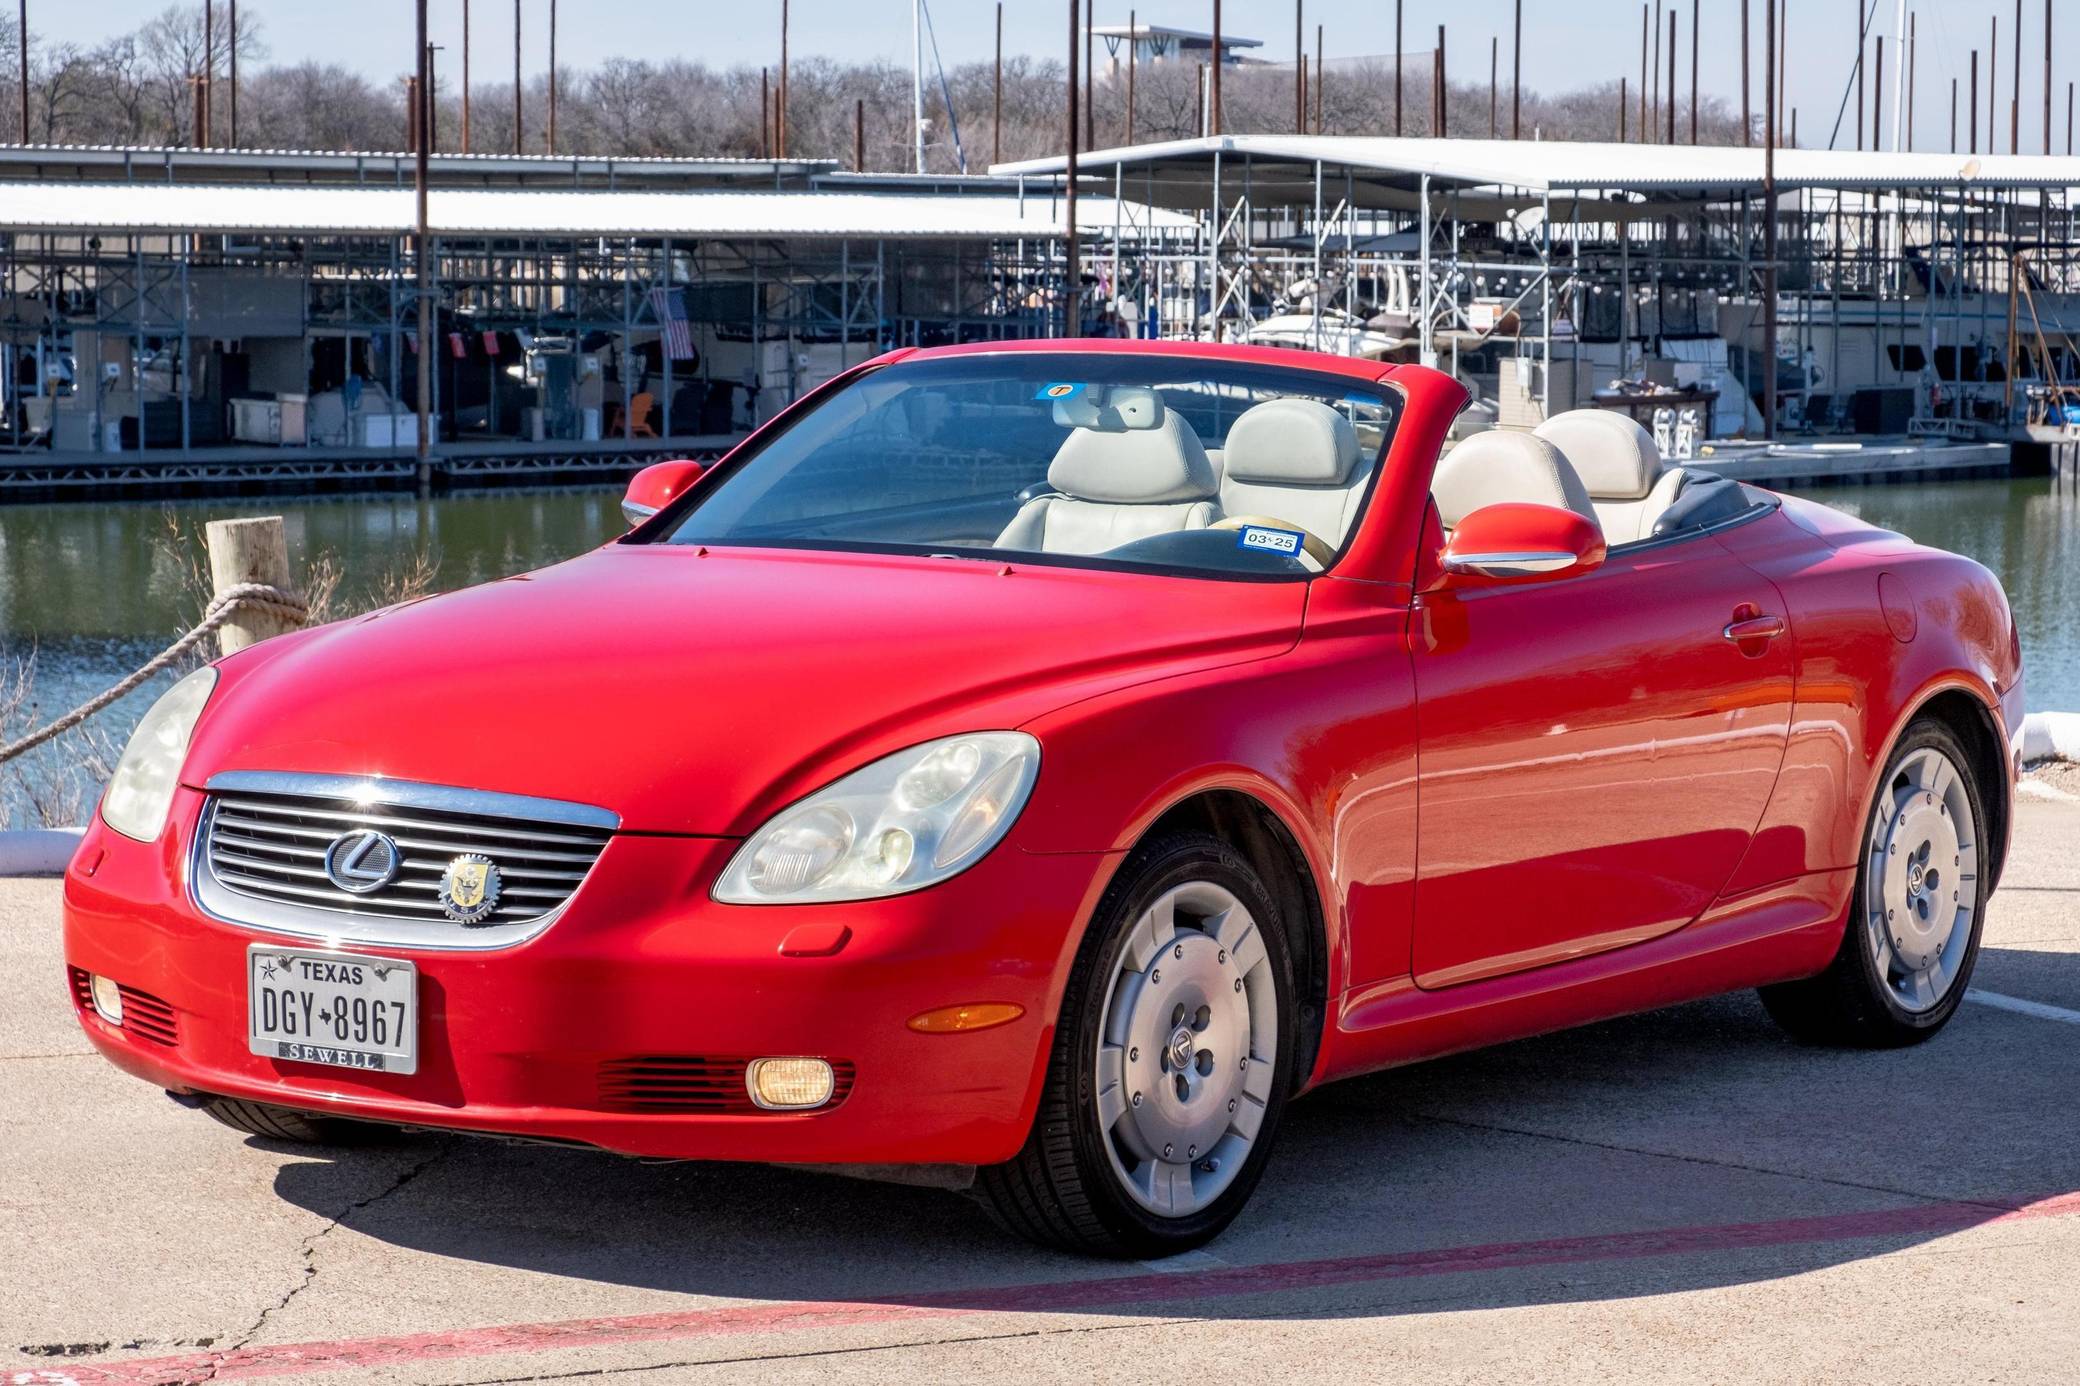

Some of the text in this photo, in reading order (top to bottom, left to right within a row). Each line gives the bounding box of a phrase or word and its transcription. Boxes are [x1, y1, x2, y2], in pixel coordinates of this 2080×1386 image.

[1248, 533, 1267, 544] 03
[1274, 537, 1294, 548] 25
[300, 961, 363, 985] TEXAS
[262, 987, 406, 1048] DGY 8967
[289, 1043, 376, 1069] SEWELL
